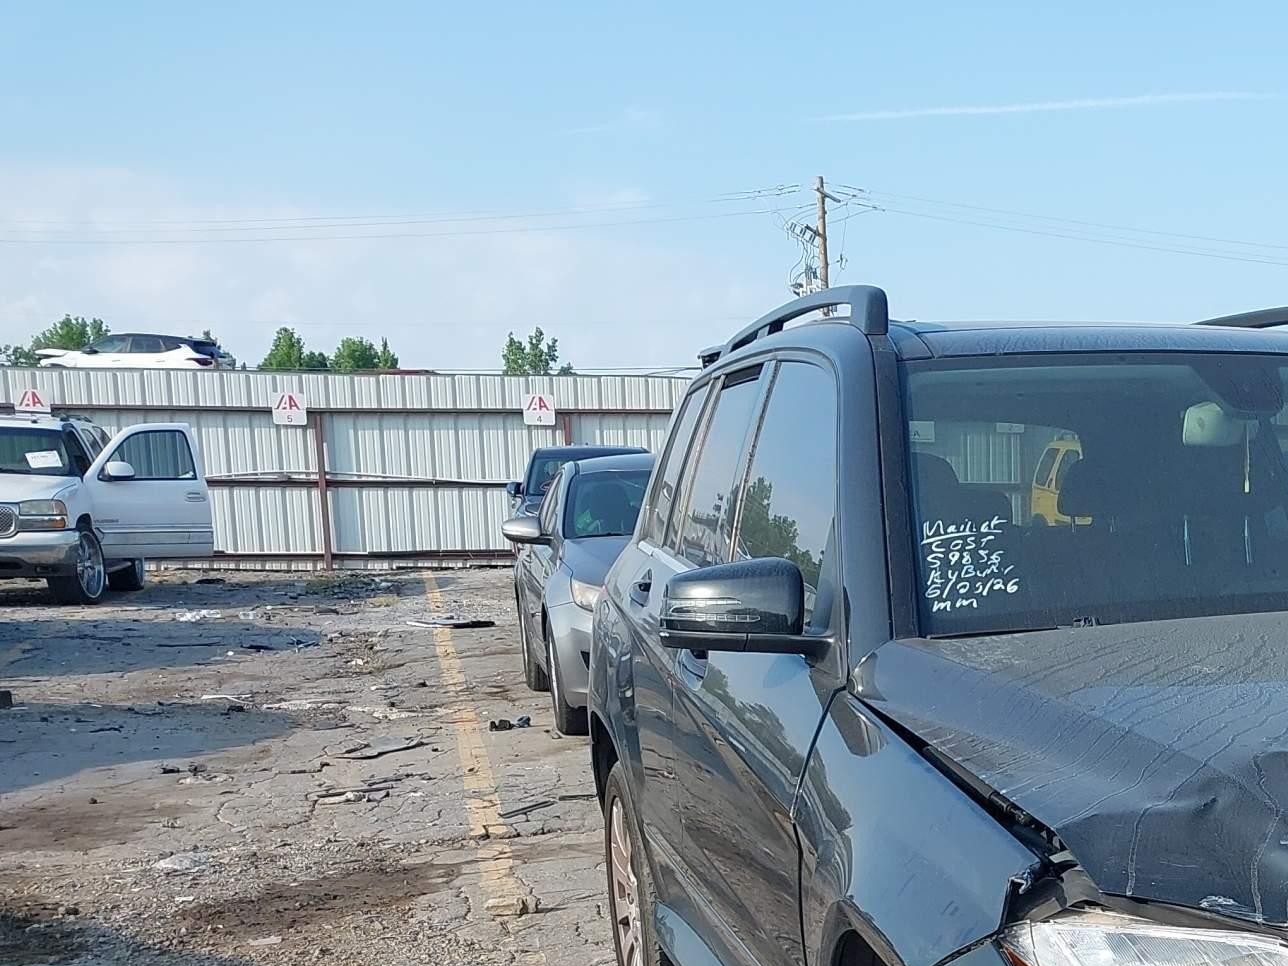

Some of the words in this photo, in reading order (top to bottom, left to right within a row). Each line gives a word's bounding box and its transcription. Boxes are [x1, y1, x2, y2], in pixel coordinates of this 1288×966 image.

[286, 414, 293, 423] 5
[536, 415, 543, 424] 4
[931, 535, 995, 552] COST
